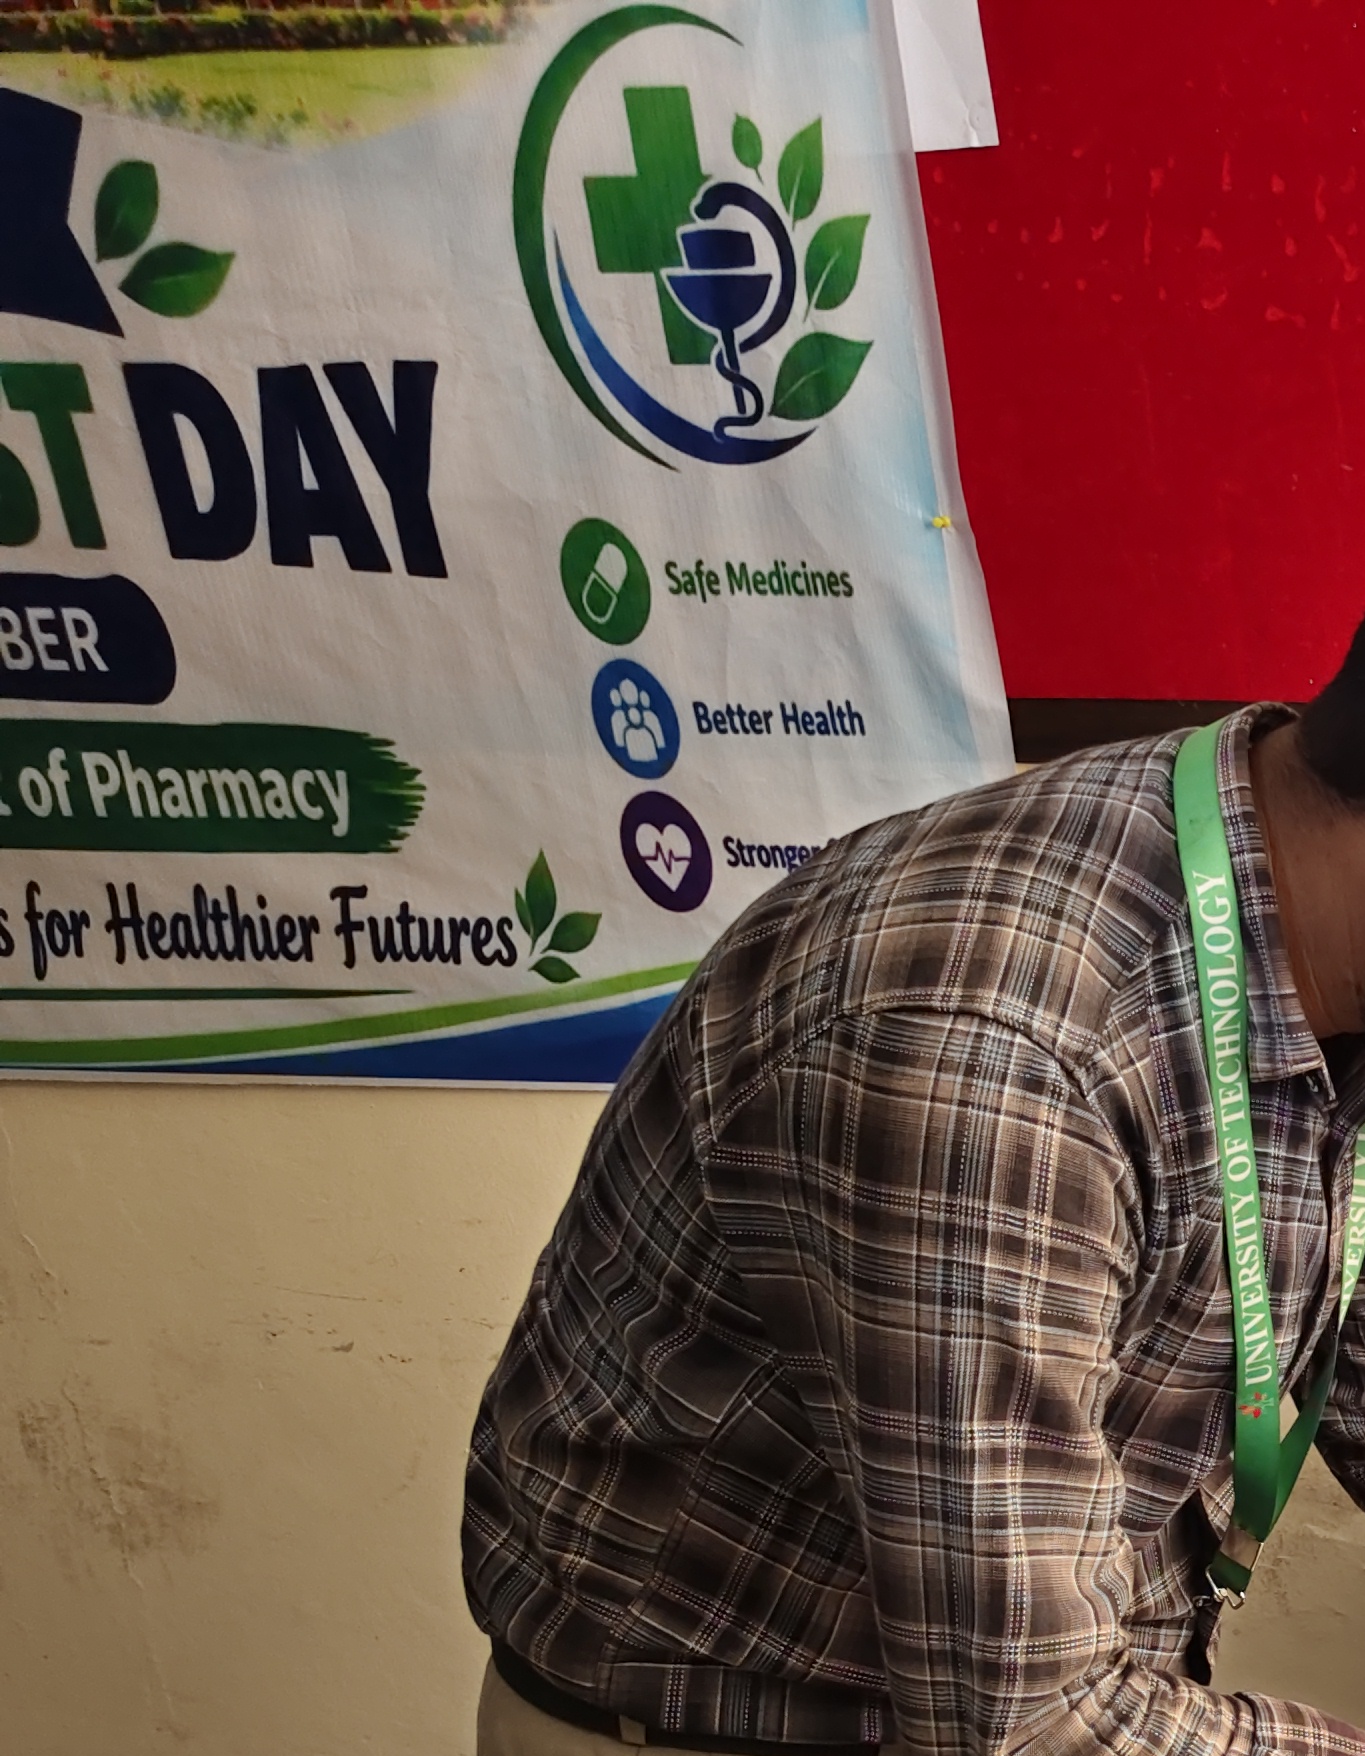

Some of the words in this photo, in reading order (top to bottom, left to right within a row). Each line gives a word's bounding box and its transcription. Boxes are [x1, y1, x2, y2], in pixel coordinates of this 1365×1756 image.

[122, 360, 449, 579] DAY
[665, 559, 720, 603] Safe
[725, 560, 853, 598] Medicines
[692, 701, 773, 734] Better
[780, 700, 865, 736] Health
[19, 748, 72, 817] of
[81, 750, 349, 836] Pharmacy
[24, 880, 90, 981] for
[105, 882, 320, 964] Healthier
[330, 885, 517, 969] Futures
[1192, 870, 1246, 1131] TECHNOLOGY
[1224, 1136, 1252, 1183] OF
[1230, 1191, 1273, 1387] UNIVERSITY
